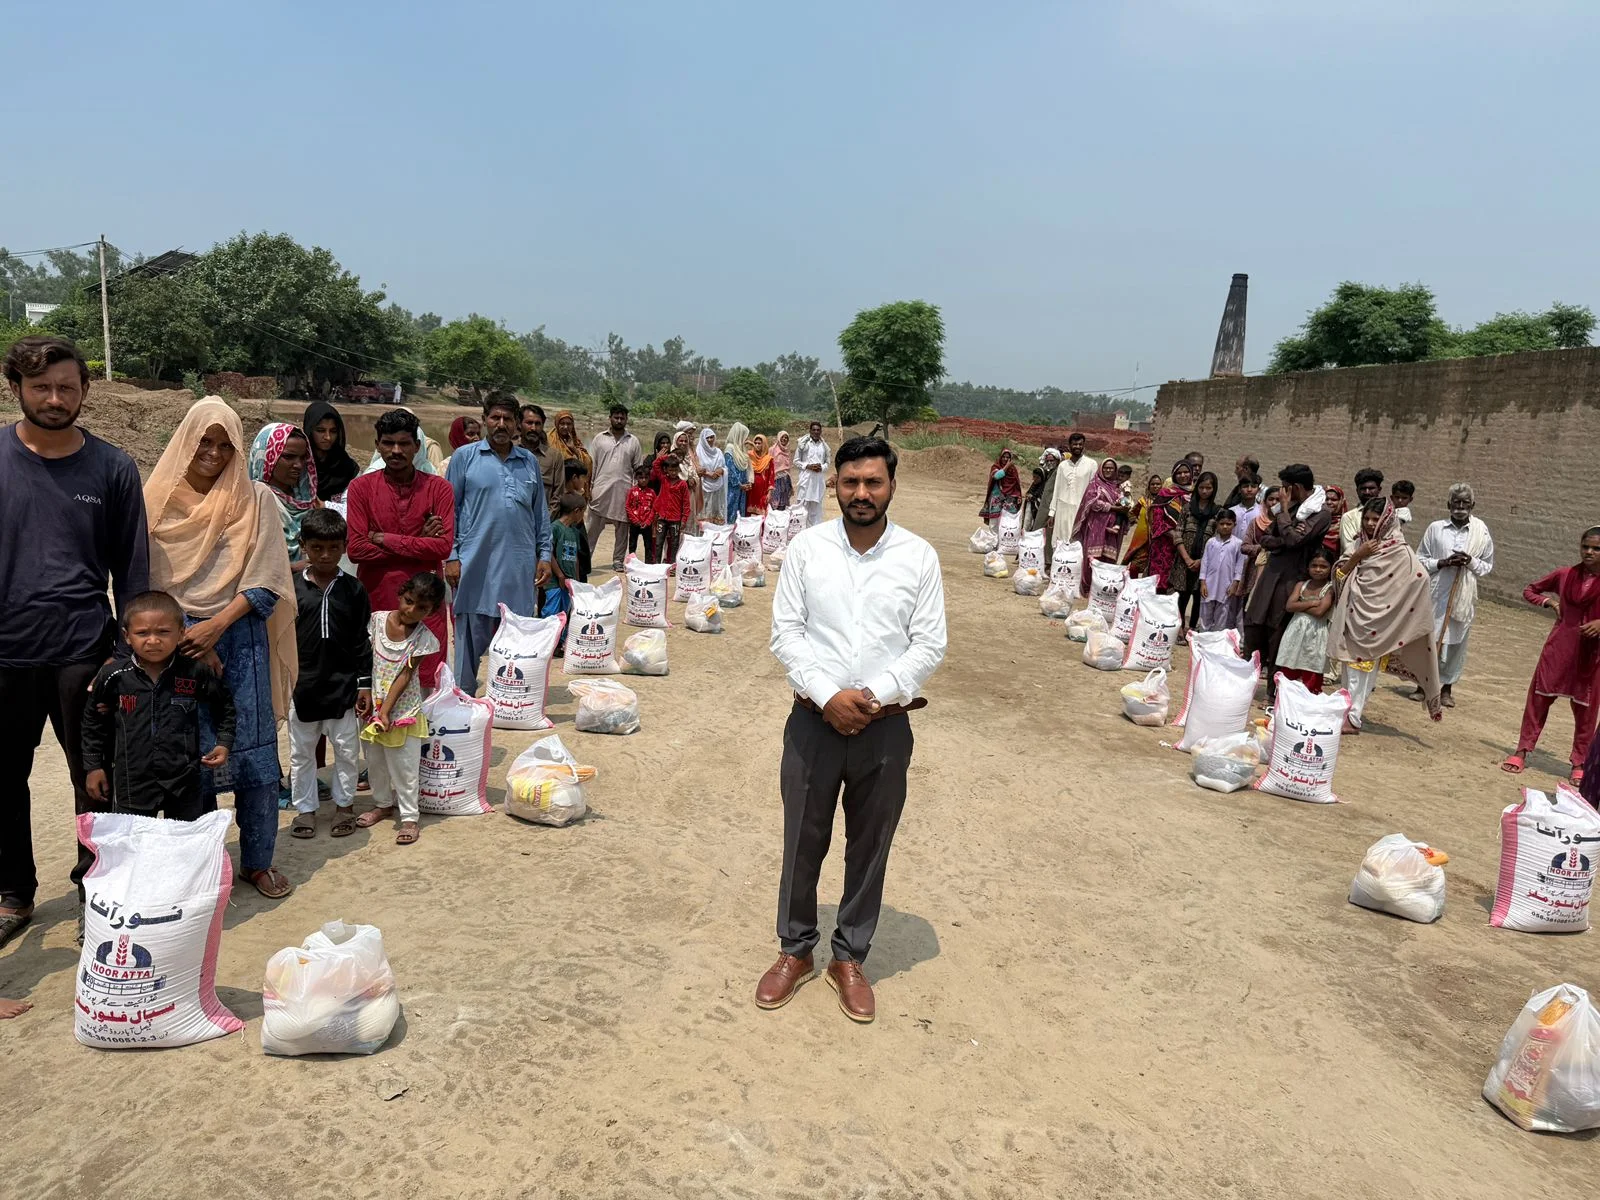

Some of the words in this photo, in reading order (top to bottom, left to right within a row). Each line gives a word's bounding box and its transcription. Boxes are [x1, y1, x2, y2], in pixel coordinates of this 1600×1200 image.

[73, 493, 102, 505] AQSA
[1301, 728, 1333, 737] نور
[1536, 821, 1566, 839] آٹا
[1549, 867, 1571, 877] NOOR
[90, 892, 124, 920] آٹا
[109, 906, 183, 930] نور
[93, 962, 119, 978] NOOR
[121, 970, 151, 980] ATTA
[90, 1009, 128, 1023] فلور
